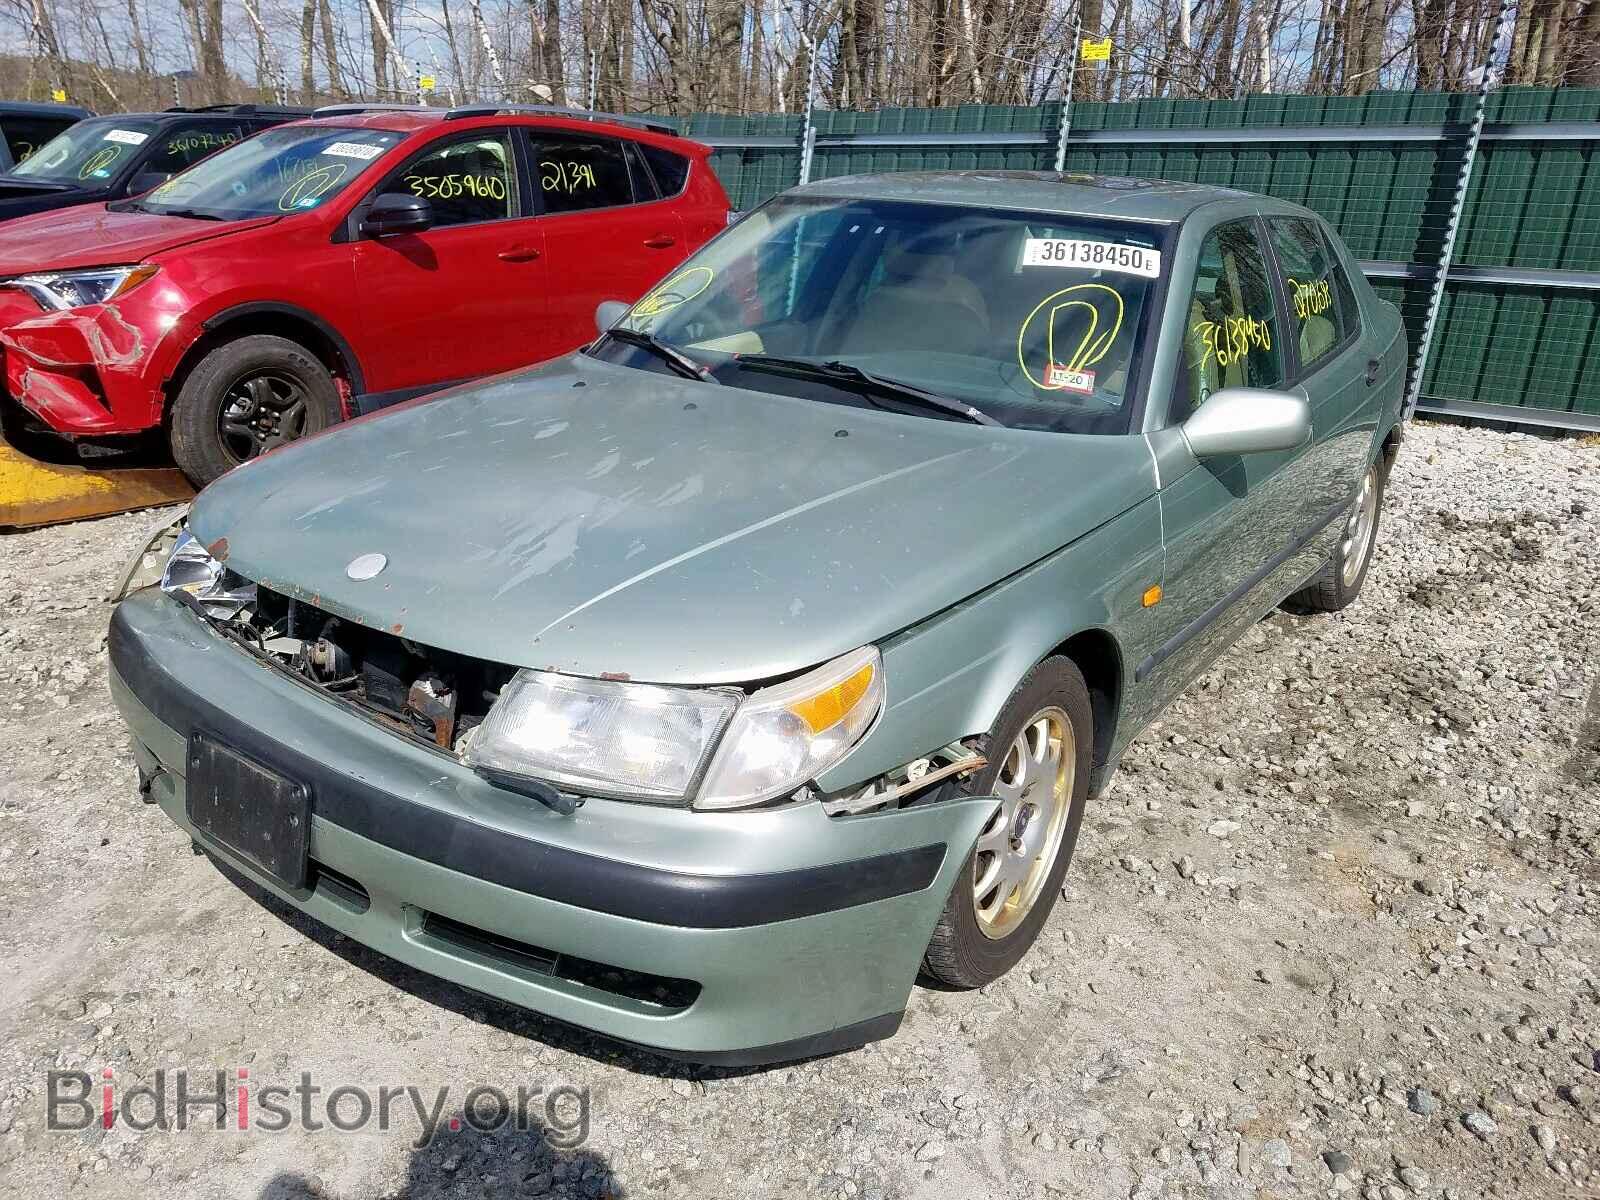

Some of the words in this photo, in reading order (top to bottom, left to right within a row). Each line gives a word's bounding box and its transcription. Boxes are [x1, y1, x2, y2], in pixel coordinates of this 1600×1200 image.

[404, 174, 506, 200] 35059610
[540, 161, 597, 194] 21,391
[1041, 241, 1143, 269] 36138450
[1193, 314, 1271, 370] 36138450
